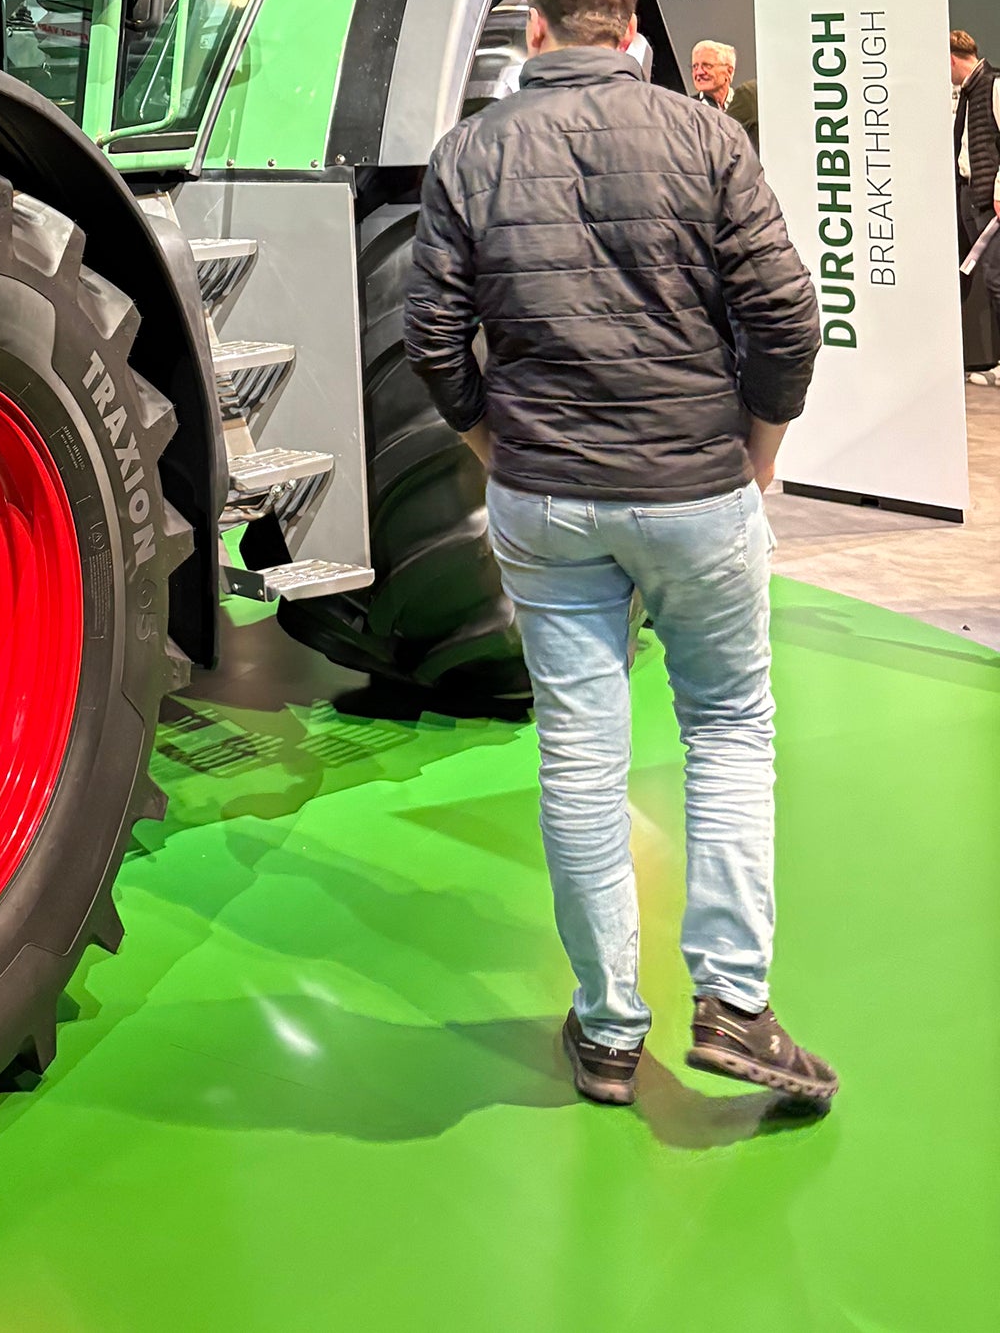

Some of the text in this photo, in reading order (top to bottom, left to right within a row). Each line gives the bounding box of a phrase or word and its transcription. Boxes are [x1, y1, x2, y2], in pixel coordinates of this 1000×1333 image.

[811, 12, 857, 348] DURCHBRUCH
[860, 11, 896, 286] BREAKTHROUGH
[81, 350, 156, 567] TRAXION
